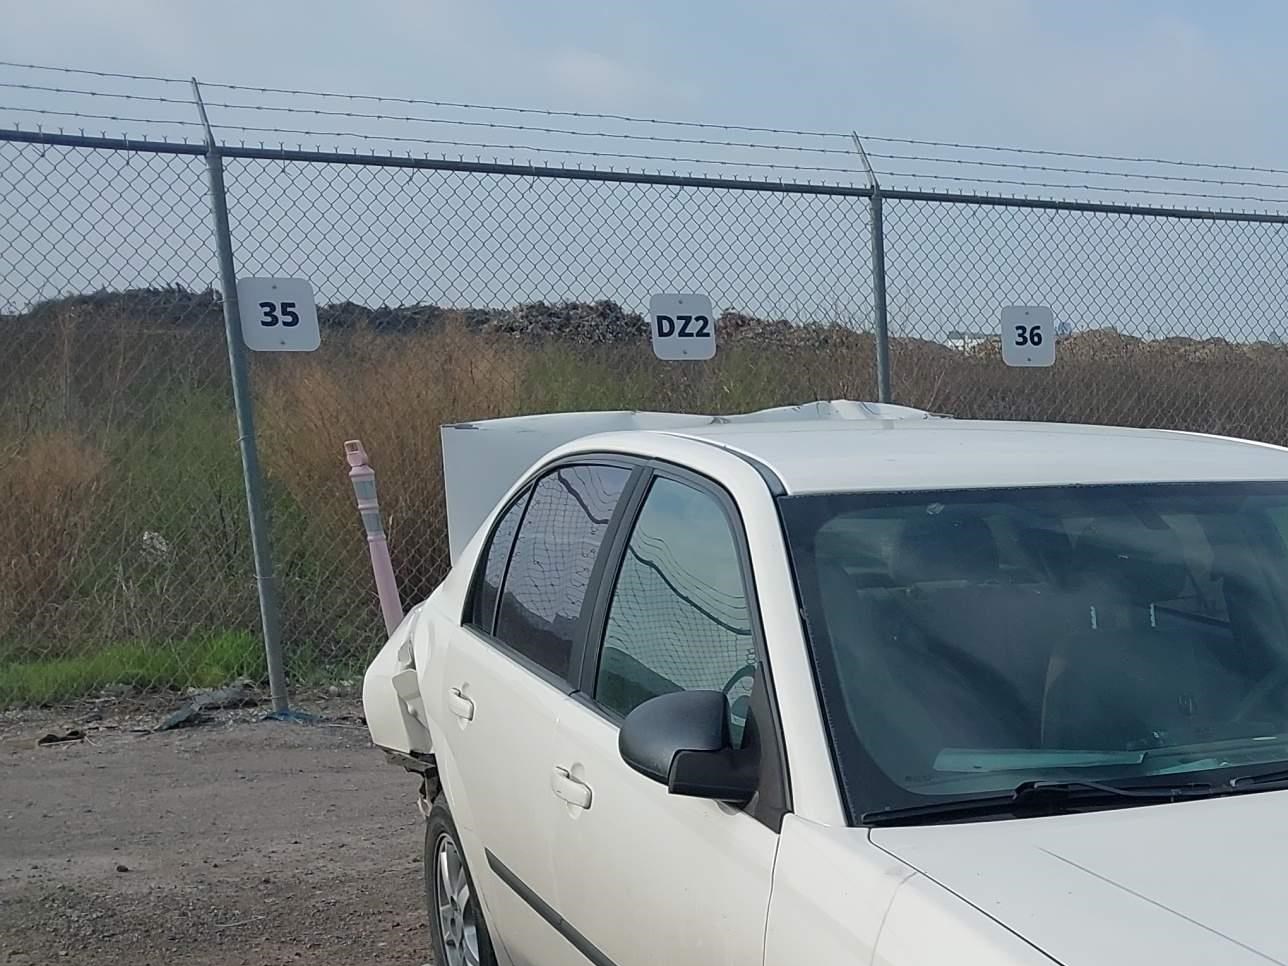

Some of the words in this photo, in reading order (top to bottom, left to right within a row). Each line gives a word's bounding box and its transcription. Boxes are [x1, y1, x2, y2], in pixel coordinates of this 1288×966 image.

[258, 301, 300, 328] 35
[655, 314, 712, 338] DZ2
[1014, 325, 1043, 347] 36
